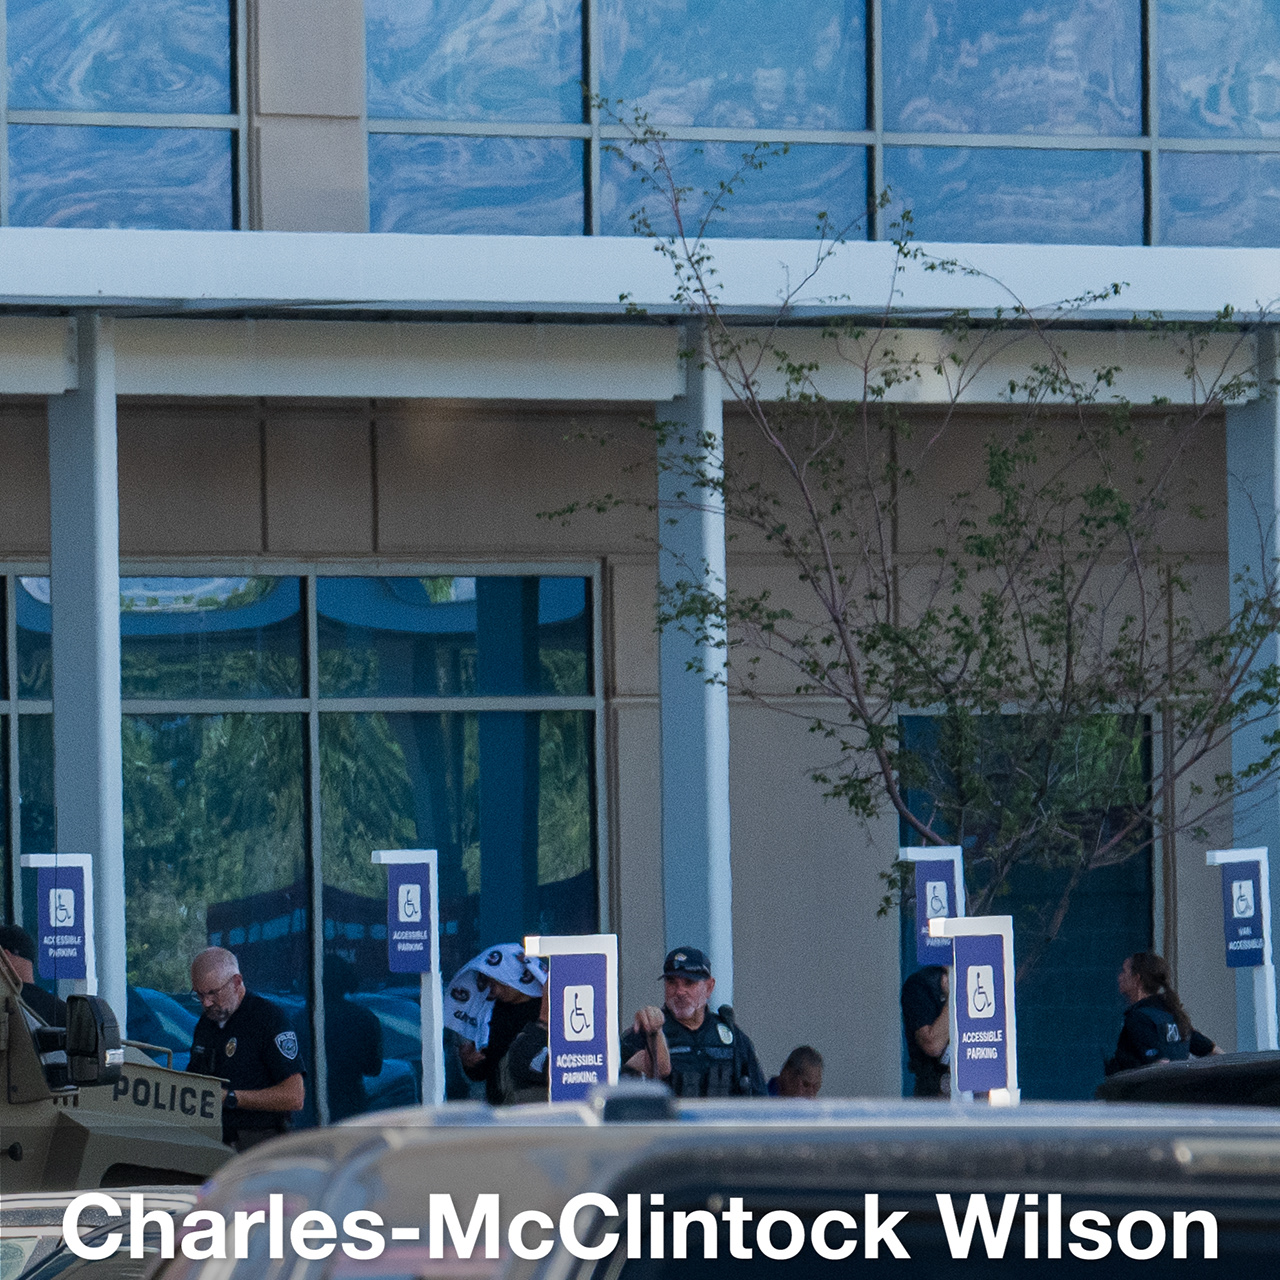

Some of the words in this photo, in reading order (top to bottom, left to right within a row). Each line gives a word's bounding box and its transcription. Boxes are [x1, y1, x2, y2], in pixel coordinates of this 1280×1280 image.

[962, 1030, 1003, 1043] ACCESSIBLE
[966, 1047, 998, 1060] PARKING
[556, 1053, 604, 1068] ACCESSIBLE
[562, 1071, 597, 1084] PARKING
[113, 1075, 215, 1119] POLICE
